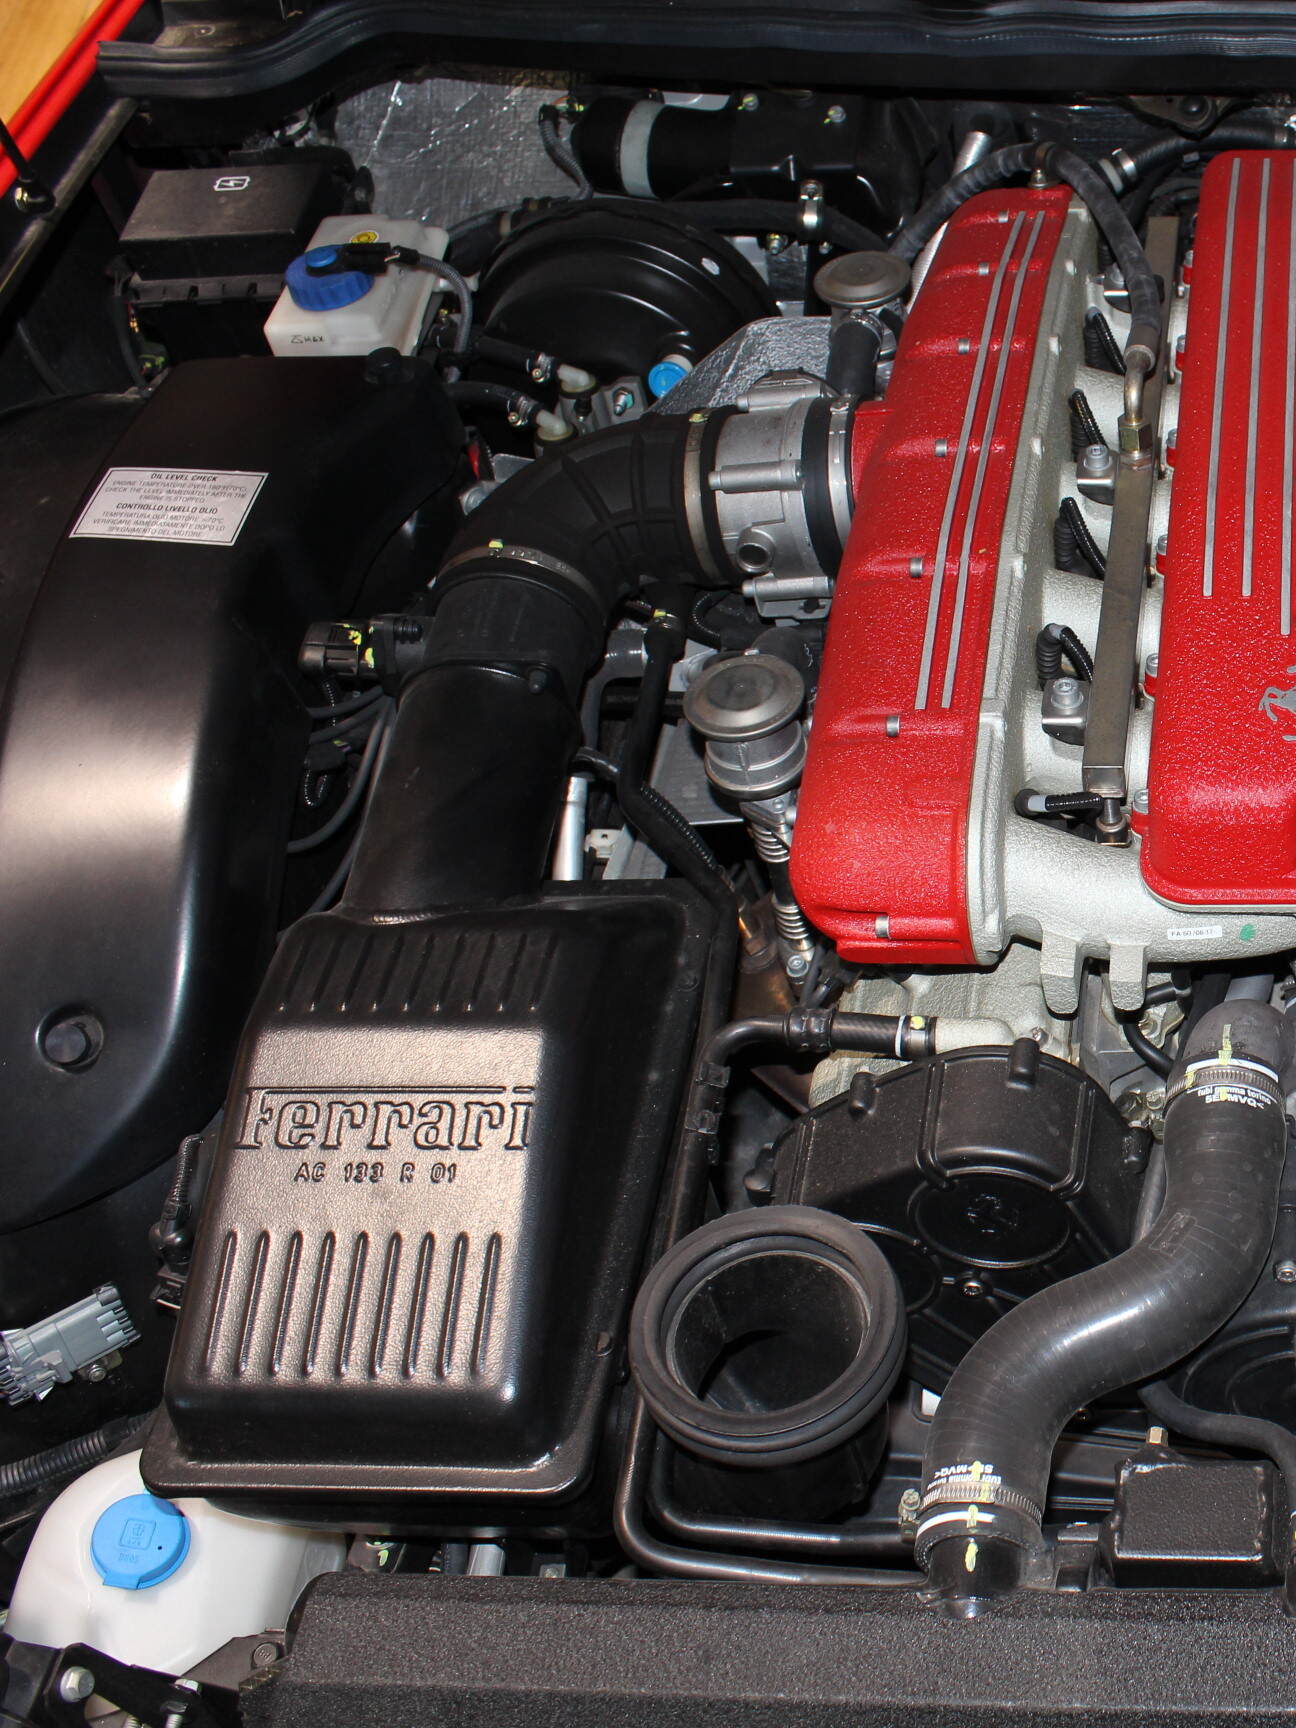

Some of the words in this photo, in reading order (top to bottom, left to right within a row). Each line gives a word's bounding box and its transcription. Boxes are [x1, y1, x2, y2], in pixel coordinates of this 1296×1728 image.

[151, 472, 164, 480] OIL
[165, 473, 189, 481] LEVEL
[191, 474, 219, 482] CHECK
[139, 480, 187, 488] TEMPERATURE
[165, 488, 210, 497] IMMEDIATELY
[116, 502, 164, 512] CONTROLLO
[164, 504, 197, 513] LIVELLO
[198, 506, 218, 515] OLIO
[102, 511, 151, 519] TEMPERATURA
[1214, 1086, 1246, 1096] gmma
[232, 1087, 536, 1151] Ferrari
[293, 1162, 326, 1183] AC
[344, 1162, 384, 1184] 133
[400, 1162, 416, 1183] R
[430, 1162, 458, 1184] 01
